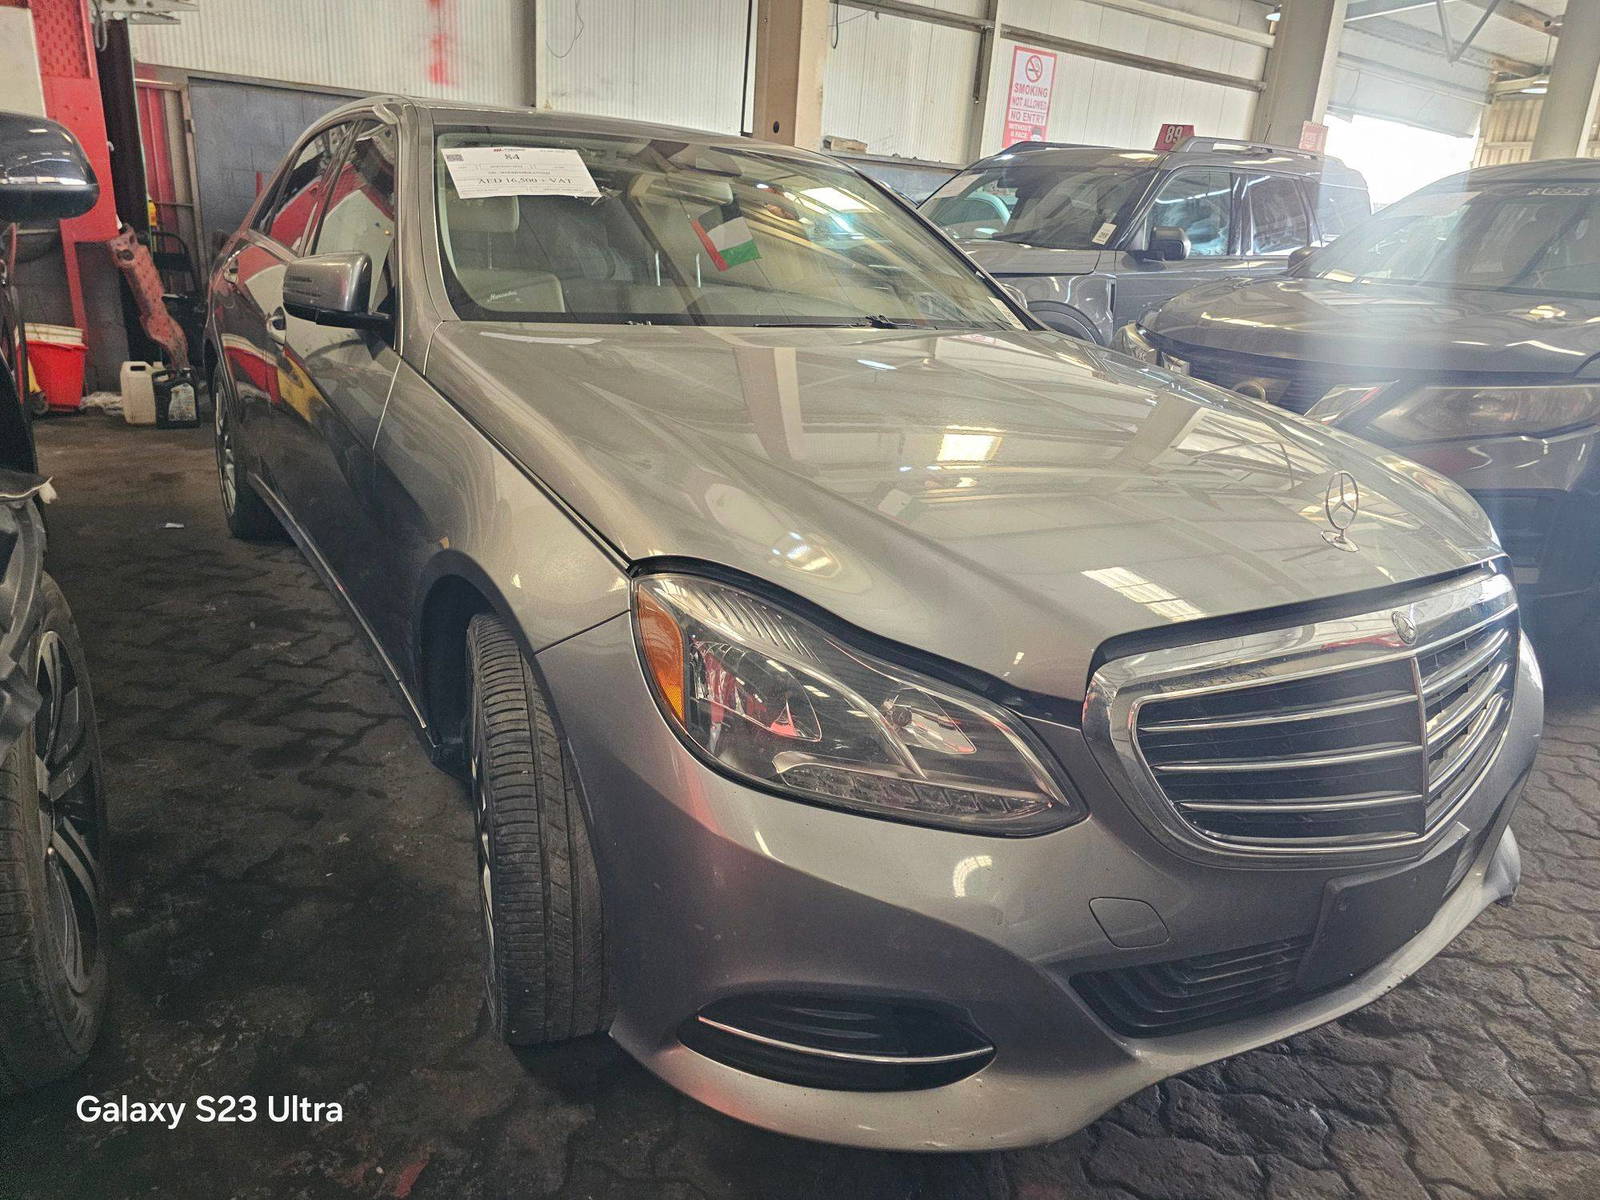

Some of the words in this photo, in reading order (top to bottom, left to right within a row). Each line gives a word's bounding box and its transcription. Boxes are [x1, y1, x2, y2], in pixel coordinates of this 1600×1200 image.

[1014, 83, 1048, 98] SMOKING
[1012, 97, 1023, 107] NOT
[1024, 99, 1047, 110] ALLOWED
[1010, 111, 1021, 120] NO
[1023, 114, 1045, 124] ENTRY
[1165, 126, 1183, 143] 89
